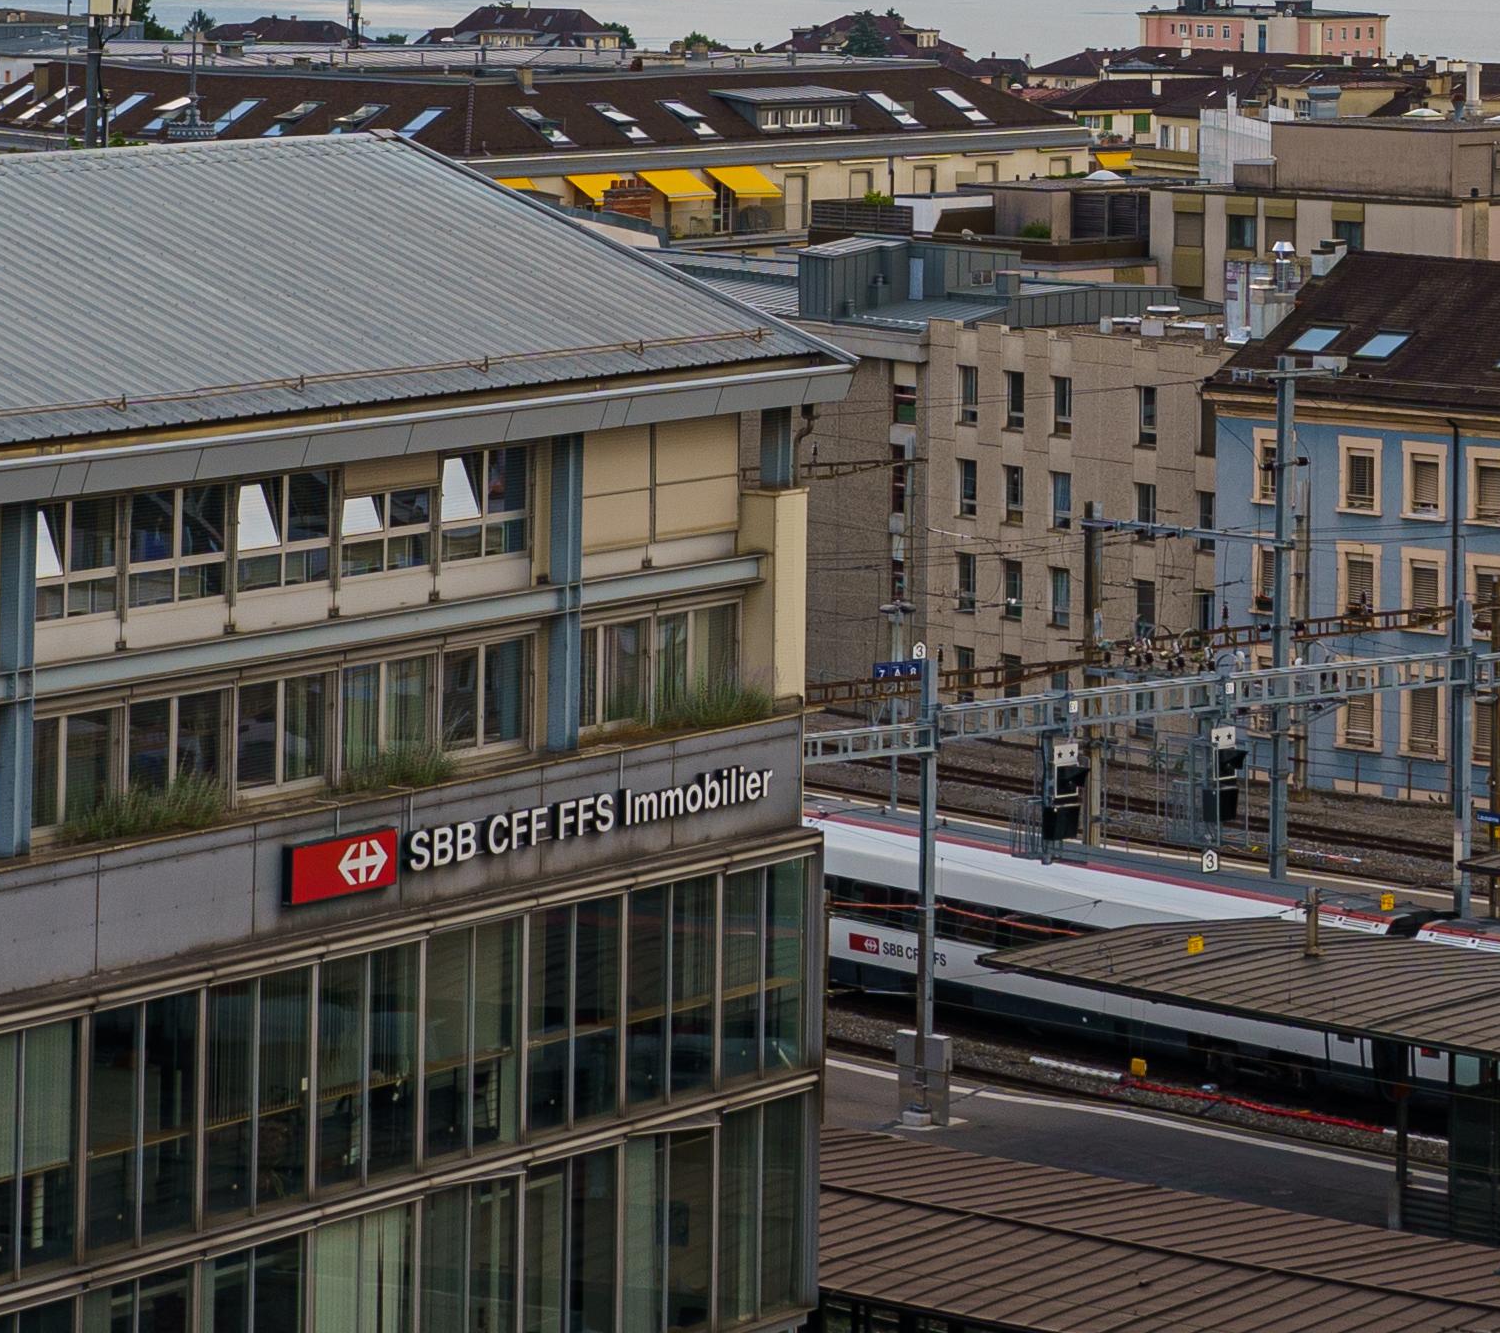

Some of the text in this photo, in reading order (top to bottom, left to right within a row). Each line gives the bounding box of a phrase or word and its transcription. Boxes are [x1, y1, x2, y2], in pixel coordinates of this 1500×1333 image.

[915, 645, 923, 658] 3
[409, 765, 774, 872] SBB CFF FFS Immobilier
[1205, 853, 1215, 870] 3
[883, 941, 904, 958] SBB
